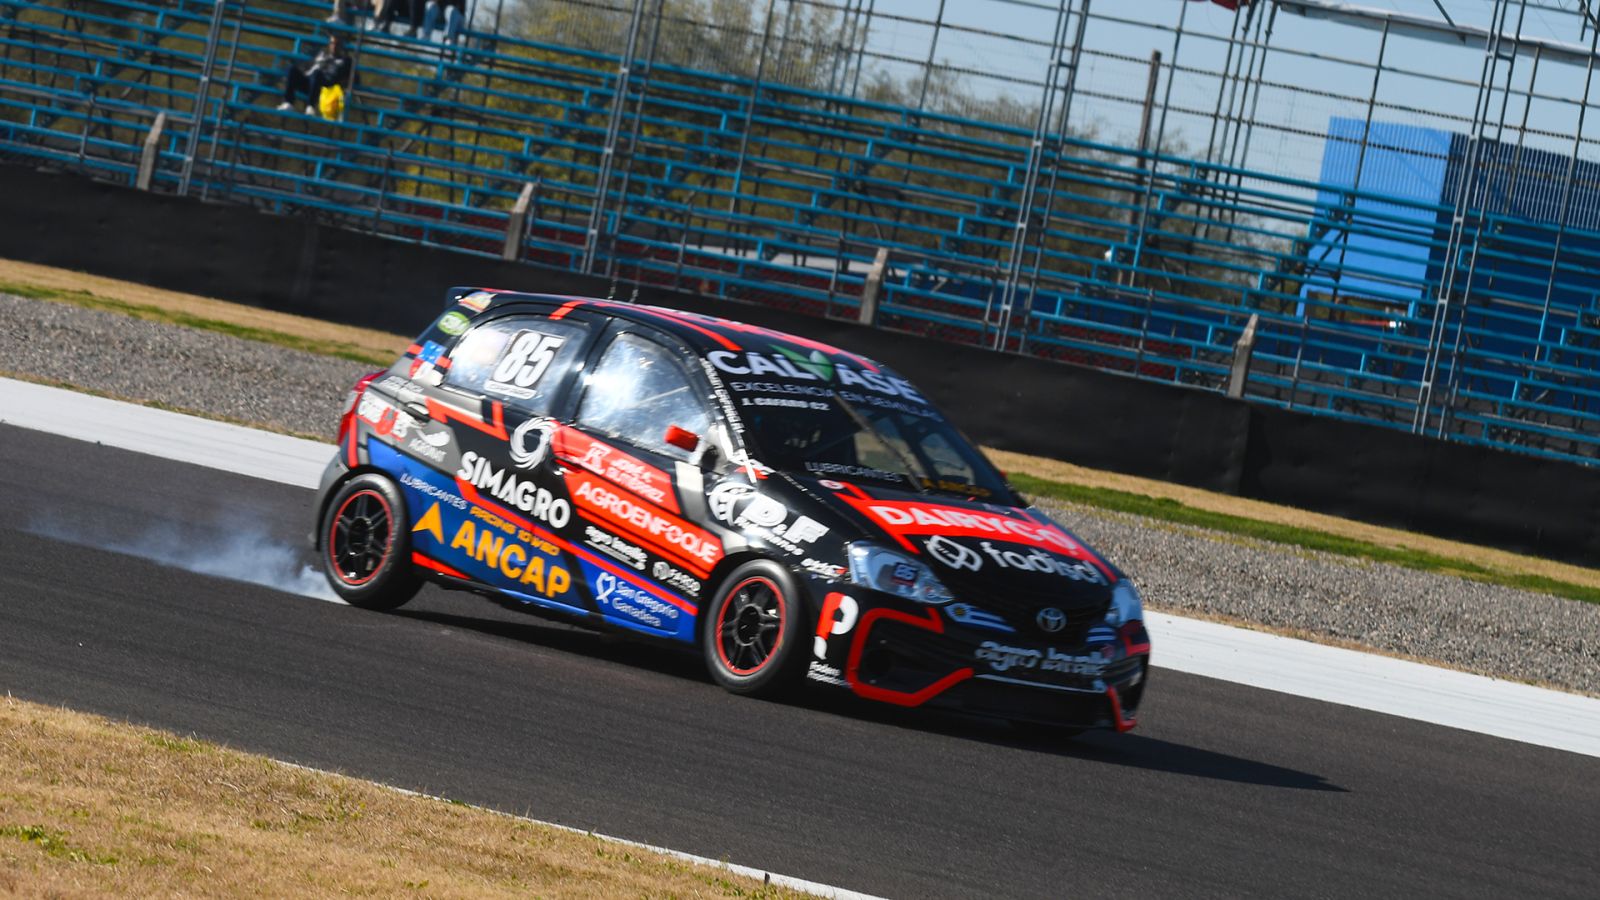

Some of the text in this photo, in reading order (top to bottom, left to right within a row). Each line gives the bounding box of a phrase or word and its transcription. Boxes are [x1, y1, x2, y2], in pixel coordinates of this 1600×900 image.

[493, 332, 565, 388] 85
[457, 451, 571, 528] SIMAGRO
[575, 481, 719, 563] AGROENFOQUE
[451, 520, 571, 598] ANCAP
